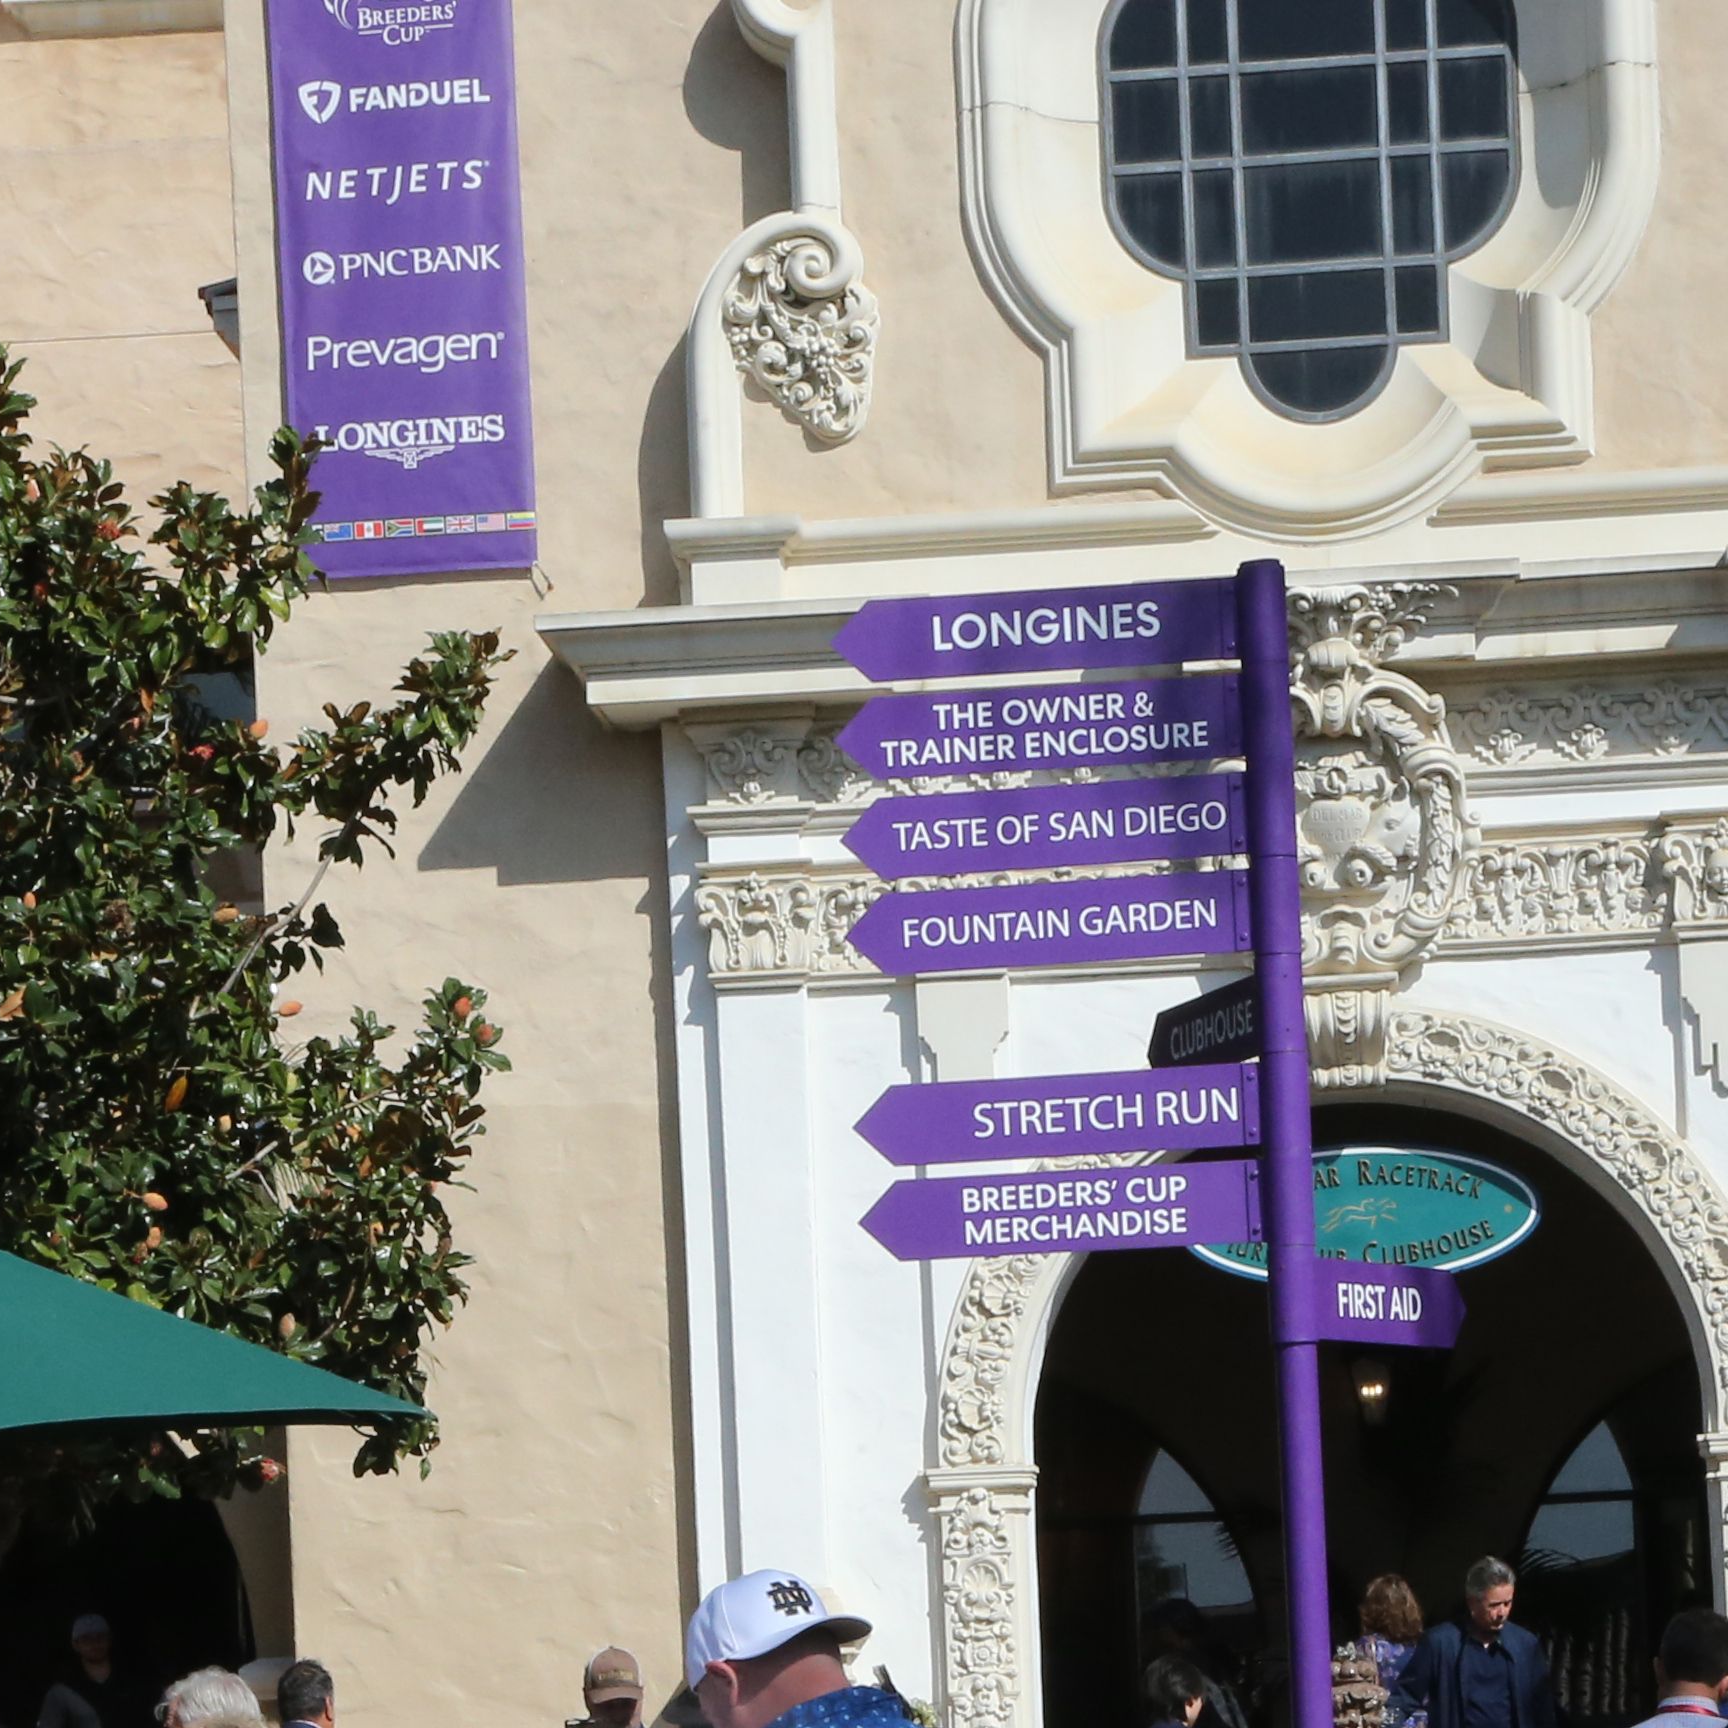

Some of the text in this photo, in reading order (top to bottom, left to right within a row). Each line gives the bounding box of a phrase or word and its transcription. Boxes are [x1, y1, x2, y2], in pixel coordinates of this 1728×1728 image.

[357, 0, 457, 29] BREEDERS'
[382, 25, 425, 46] CUP
[349, 78, 491, 112] FANDUEL
[306, 159, 483, 205] NETJETS
[306, 332, 498, 373] Prevagen
[315, 414, 505, 452] LONGINES
[932, 602, 1160, 651] LONGINES
[932, 691, 1154, 730] THE OWNER &
[880, 721, 1209, 767] TRAINER ENCLOSURE
[892, 801, 1227, 852] TASTE OF SAN DIEGO
[902, 898, 1217, 948] FOUNTAIN GARDEN
[1170, 999, 1253, 1060] CLUBHOUSE
[973, 1087, 1238, 1138] STRETCH RUN
[962, 1176, 1187, 1213] BREEDERS' CUP
[1314, 1158, 1486, 1200] AR RACETRACK
[964, 1208, 1187, 1245] MERCHANDISE
[1363, 1221, 1495, 1265] CLUBHOUSE
[1337, 1282, 1422, 1322] FIRST AID
